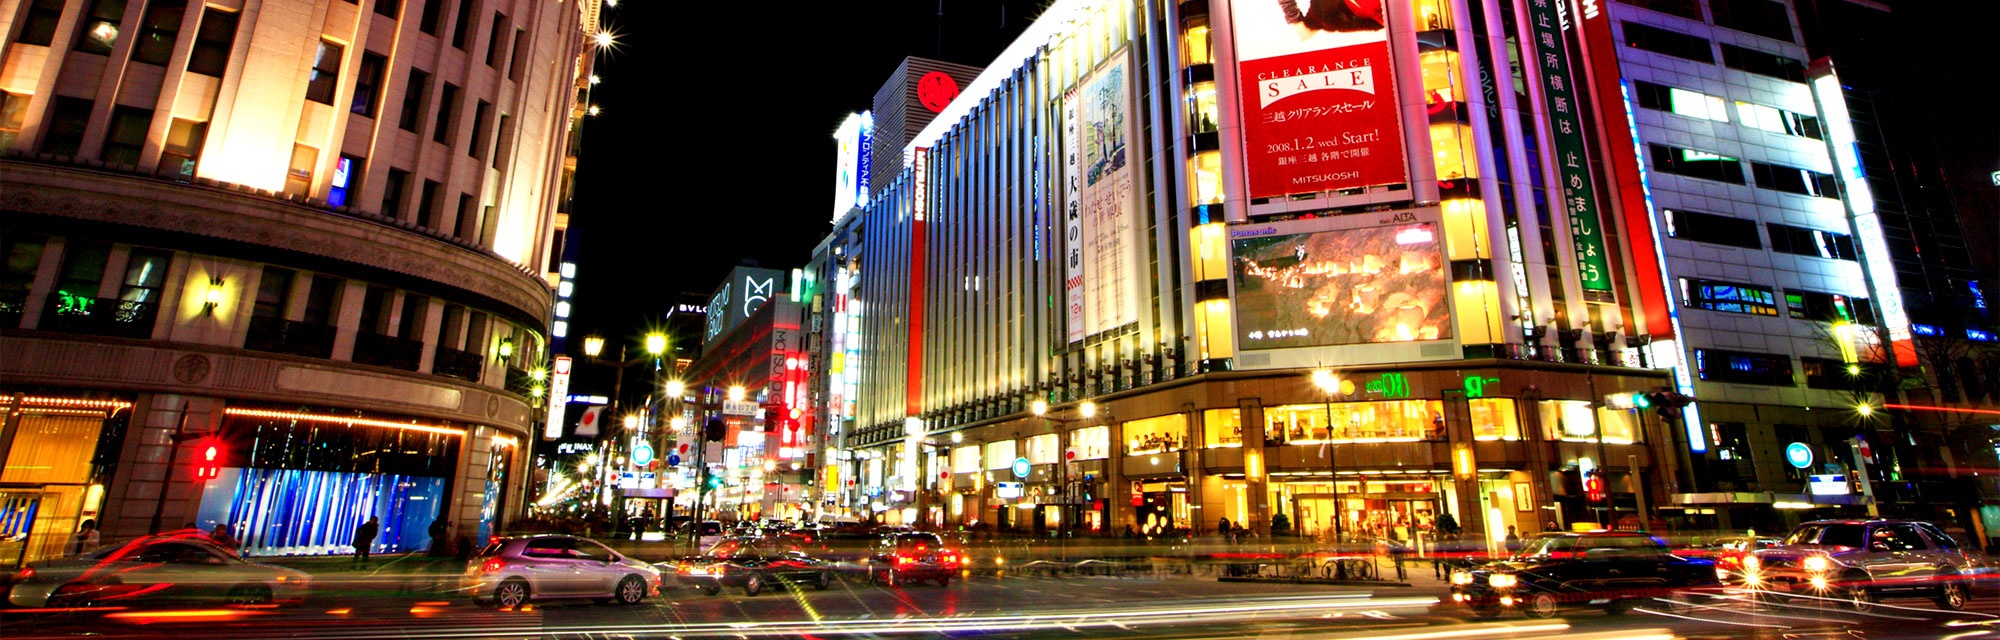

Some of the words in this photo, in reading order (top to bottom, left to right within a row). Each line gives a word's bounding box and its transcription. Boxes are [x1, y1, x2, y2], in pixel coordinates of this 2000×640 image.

[1258, 58, 1371, 81] CLEARANCE
[1268, 70, 1365, 97] SALE
[1262, 100, 1375, 123] 三越クリアランスセール
[1267, 136, 1315, 154] 2008.1.2
[1342, 129, 1379, 146] Start!
[1277, 153, 1318, 166] 銀座三越
[914, 150, 926, 221] MITSUKOSHI
[1293, 171, 1359, 185] MITSUKOSHI
[1567, 151, 1599, 282] 止めましょう
[1231, 227, 1277, 238] Panasonic
